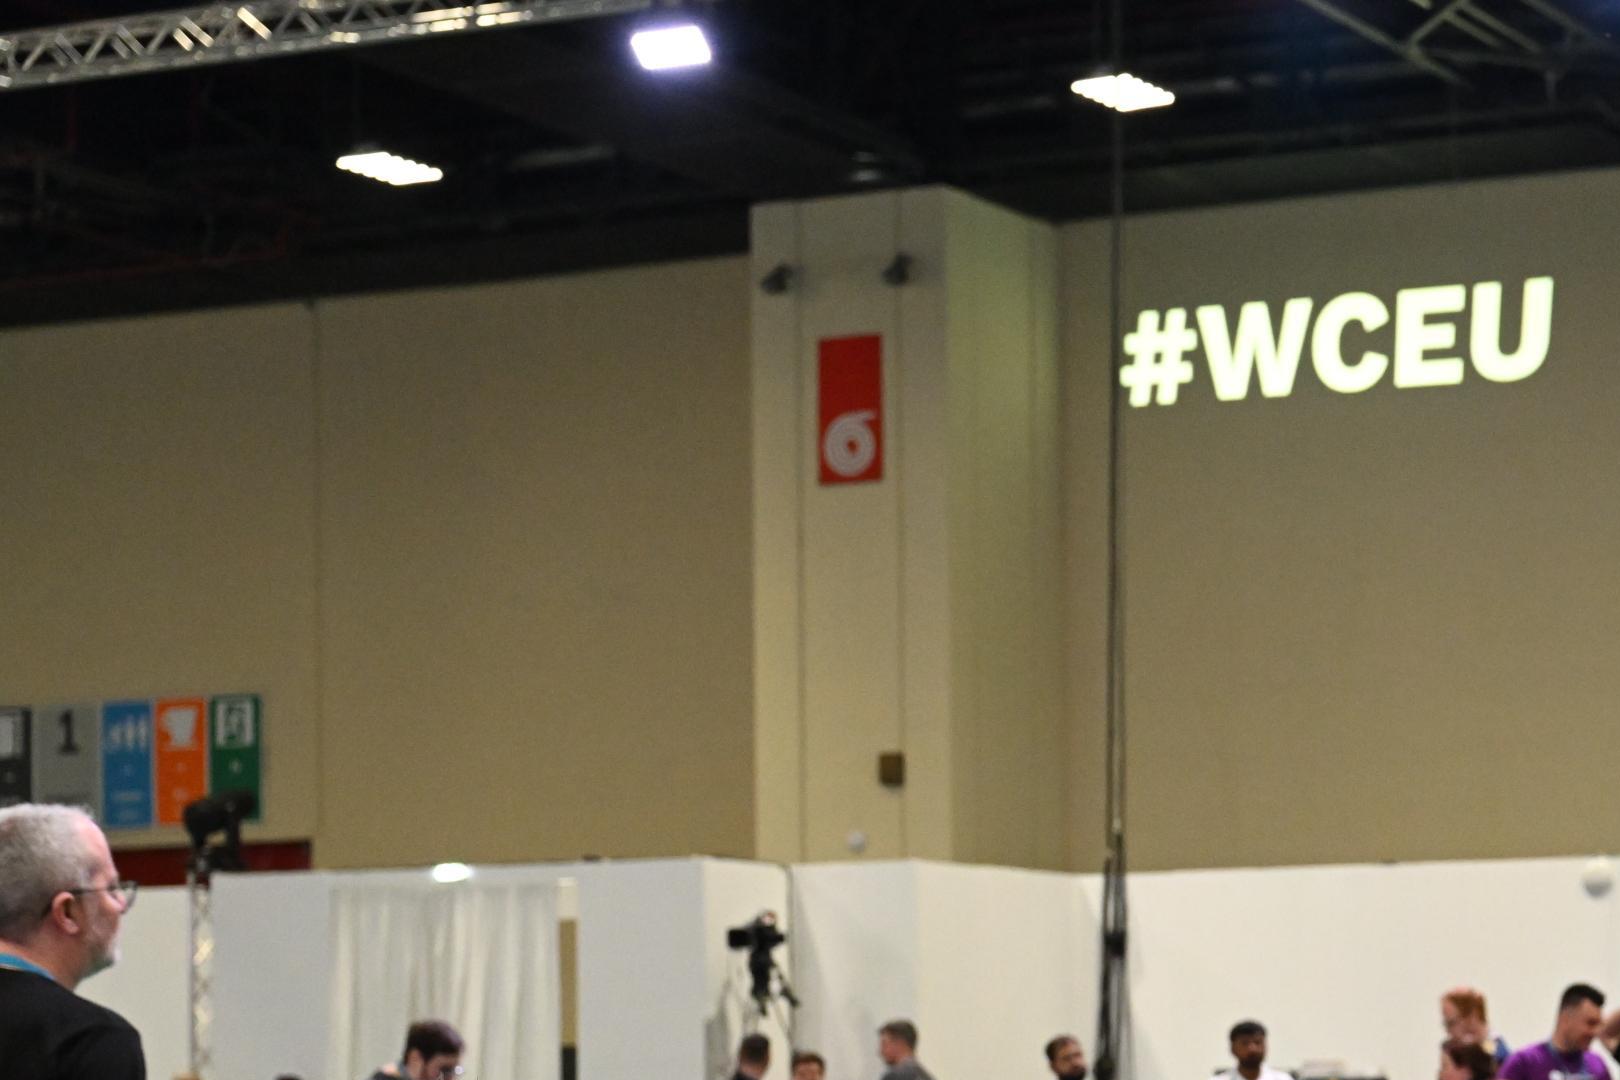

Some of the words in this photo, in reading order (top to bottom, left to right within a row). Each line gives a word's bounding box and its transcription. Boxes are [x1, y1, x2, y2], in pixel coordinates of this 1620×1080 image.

[1119, 275, 1535, 409] #WCEU
[824, 409, 878, 478] 6
[59, 708, 78, 756] 1
